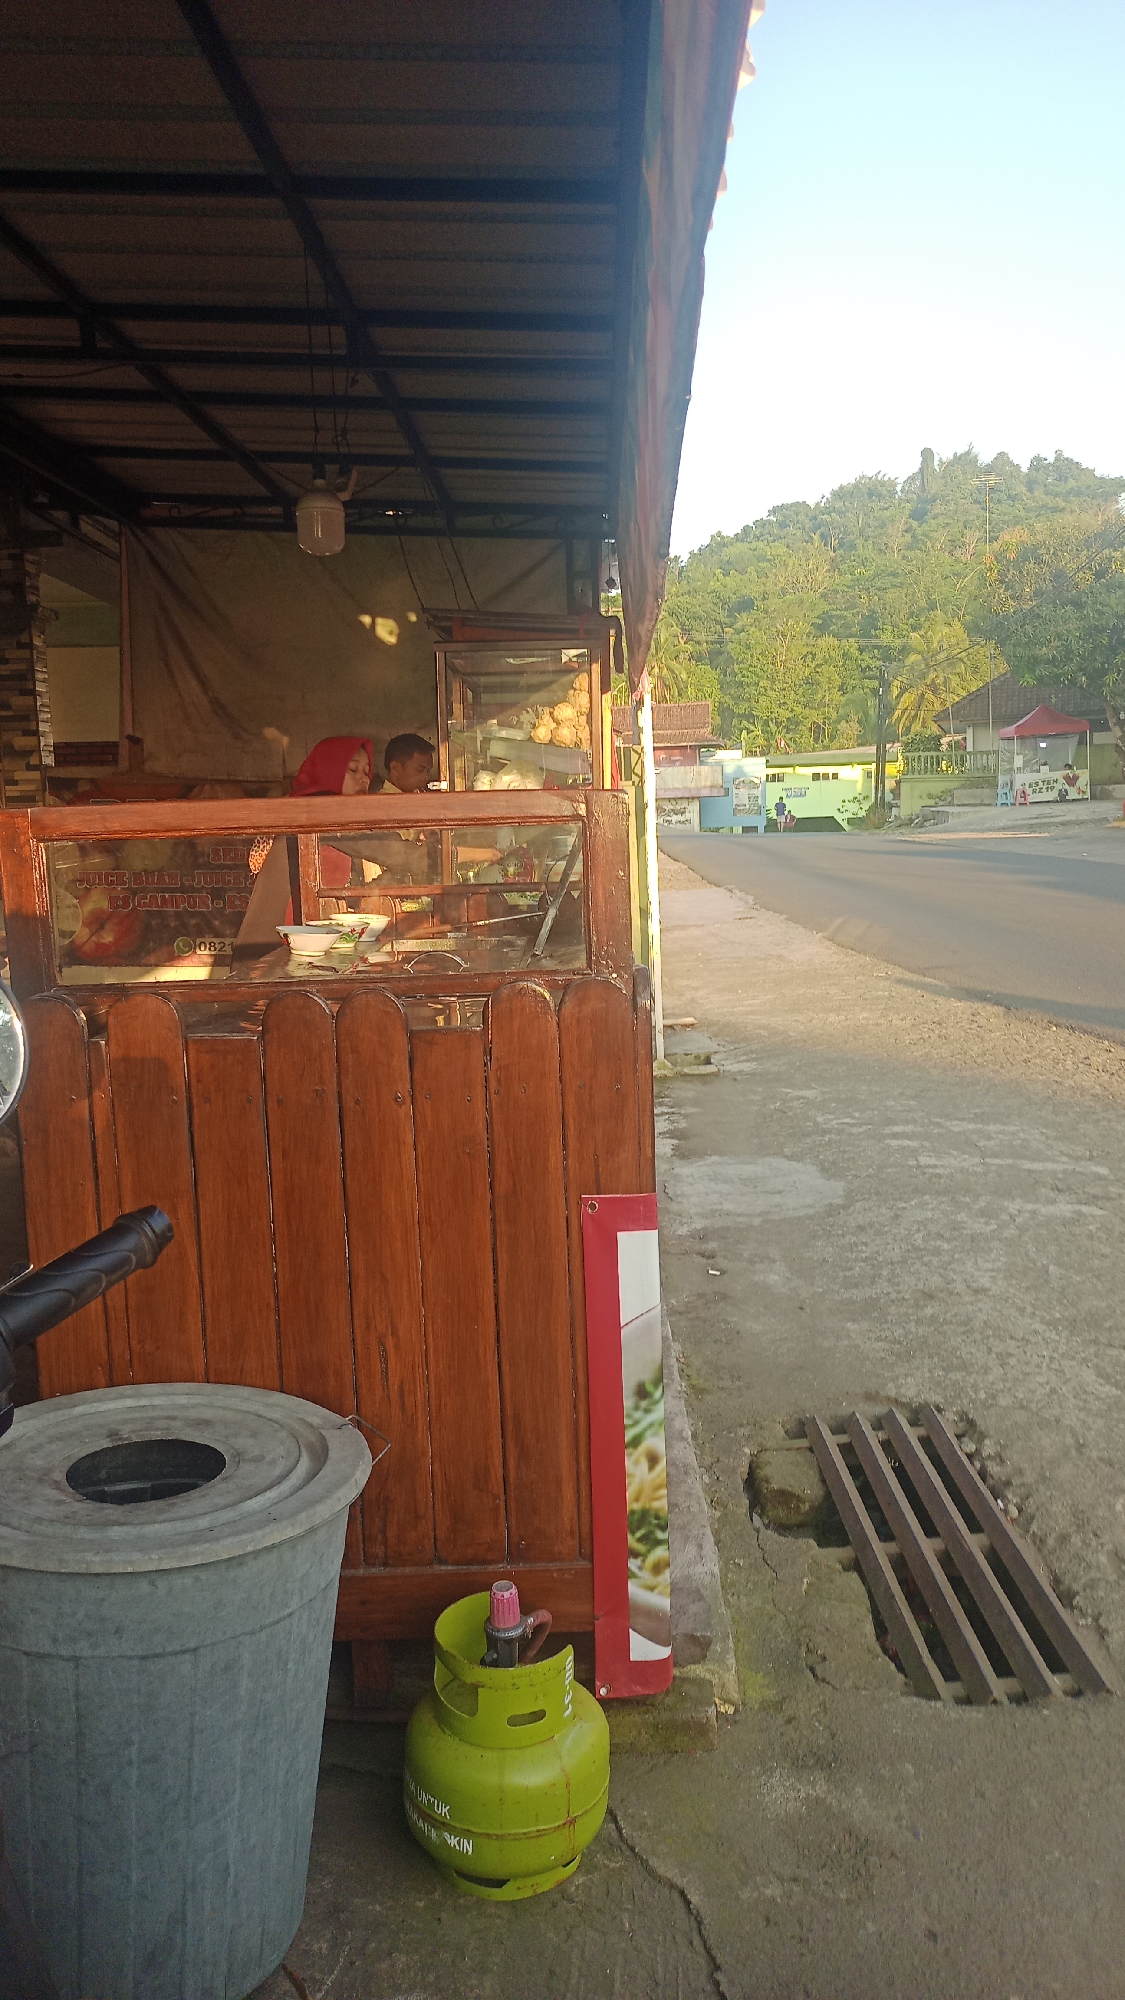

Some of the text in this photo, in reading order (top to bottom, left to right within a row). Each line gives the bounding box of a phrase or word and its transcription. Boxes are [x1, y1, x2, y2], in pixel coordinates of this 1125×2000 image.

[1028, 781, 1040, 789] ES
[1045, 785, 1056, 793] 19
[76, 870, 129, 888] JUICE
[131, 870, 181, 888] BUAH
[194, 870, 245, 887] JUICE
[108, 893, 133, 911] ES
[136, 893, 212, 911] CAMPUR
[225, 893, 251, 911] ES
